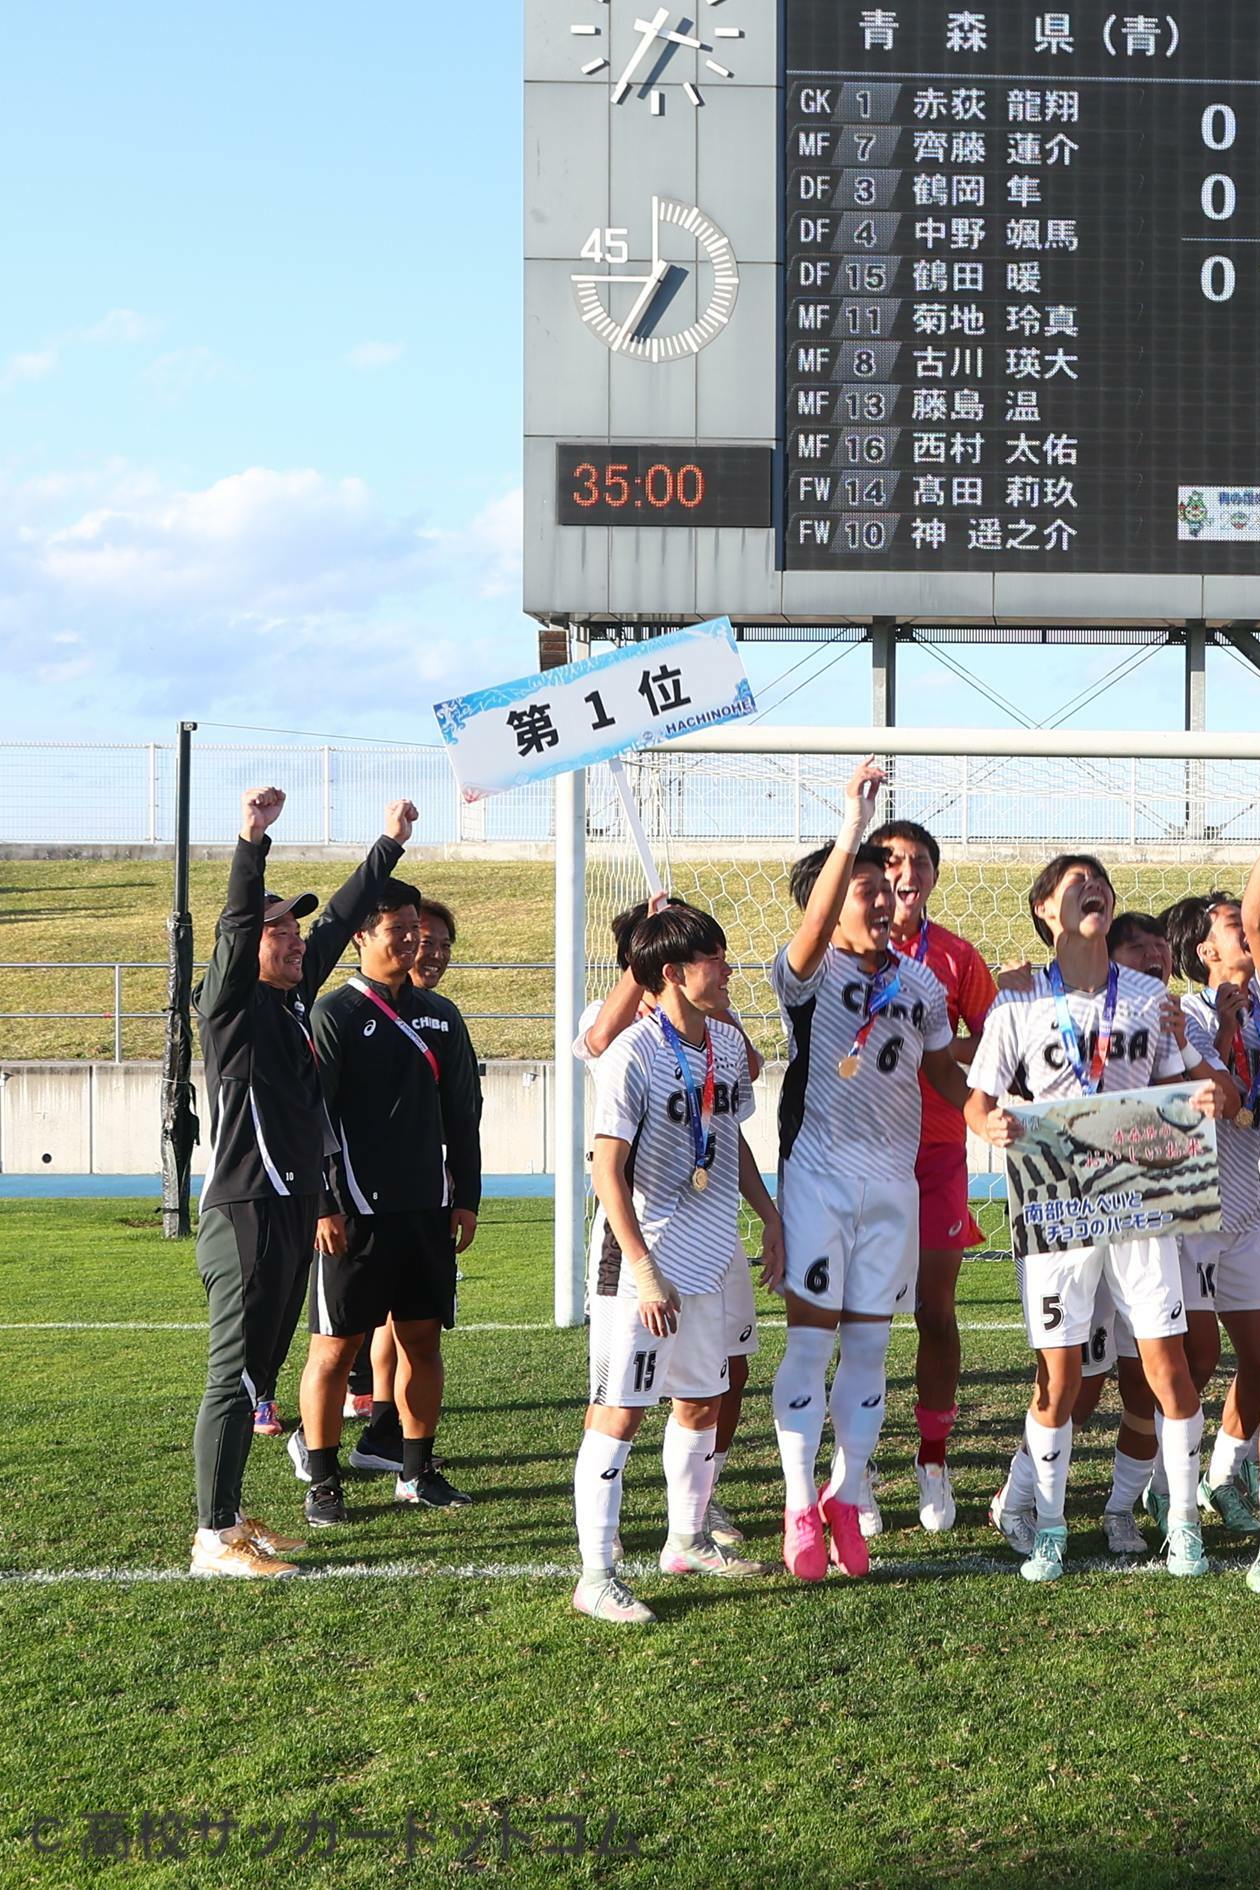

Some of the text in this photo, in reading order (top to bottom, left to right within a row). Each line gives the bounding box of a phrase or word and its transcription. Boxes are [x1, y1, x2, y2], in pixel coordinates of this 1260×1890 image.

[801, 89, 831, 113] GK
[857, 91, 871, 118] 1
[1008, 89, 1078, 121] 龍翔
[1201, 103, 1236, 150] 0
[799, 132, 830, 156] MF
[854, 134, 876, 161] 7
[1007, 133, 1078, 165] 蓮介
[801, 176, 830, 199] DF
[854, 177, 875, 205] 3
[914, 174, 1040, 207] 鶴岡 隼
[1201, 174, 1236, 220] 0
[801, 218, 829, 242] DF
[854, 221, 877, 247] 4
[916, 218, 1078, 250] 中野 颯馬
[580, 228, 628, 263] 45
[800, 262, 829, 285] DF
[846, 263, 885, 290] 15
[913, 260, 1040, 292] 鶴田 暖
[1200, 255, 1235, 301] 0
[799, 305, 829, 328] MF
[846, 308, 881, 335] 11
[913, 304, 1078, 336] 菊地 玲真
[799, 348, 829, 371] MF
[854, 350, 876, 377] 8
[914, 346, 1078, 379] 古川 瑛大
[798, 391, 829, 414] MF
[846, 394, 885, 420] 13
[912, 389, 1040, 421] 藤島 温
[799, 434, 829, 457] MF
[845, 436, 885, 463] 16
[913, 433, 1077, 464] 西村 太佑
[573, 463, 704, 507] 35:00
[800, 477, 830, 501] FW
[845, 479, 885, 506] 14
[1006, 476, 1077, 507] 莉玖
[800, 520, 830, 544] FW
[845, 522, 885, 549] 10
[912, 518, 945, 549] 神
[666, 701, 750, 734] HACHINOHE
[411, 1016, 449, 1035] CHIBA
[875, 1037, 904, 1076] 6
[804, 1255, 830, 1295] 6
[1041, 1294, 1065, 1333] 5
[633, 1349, 656, 1392] 15
